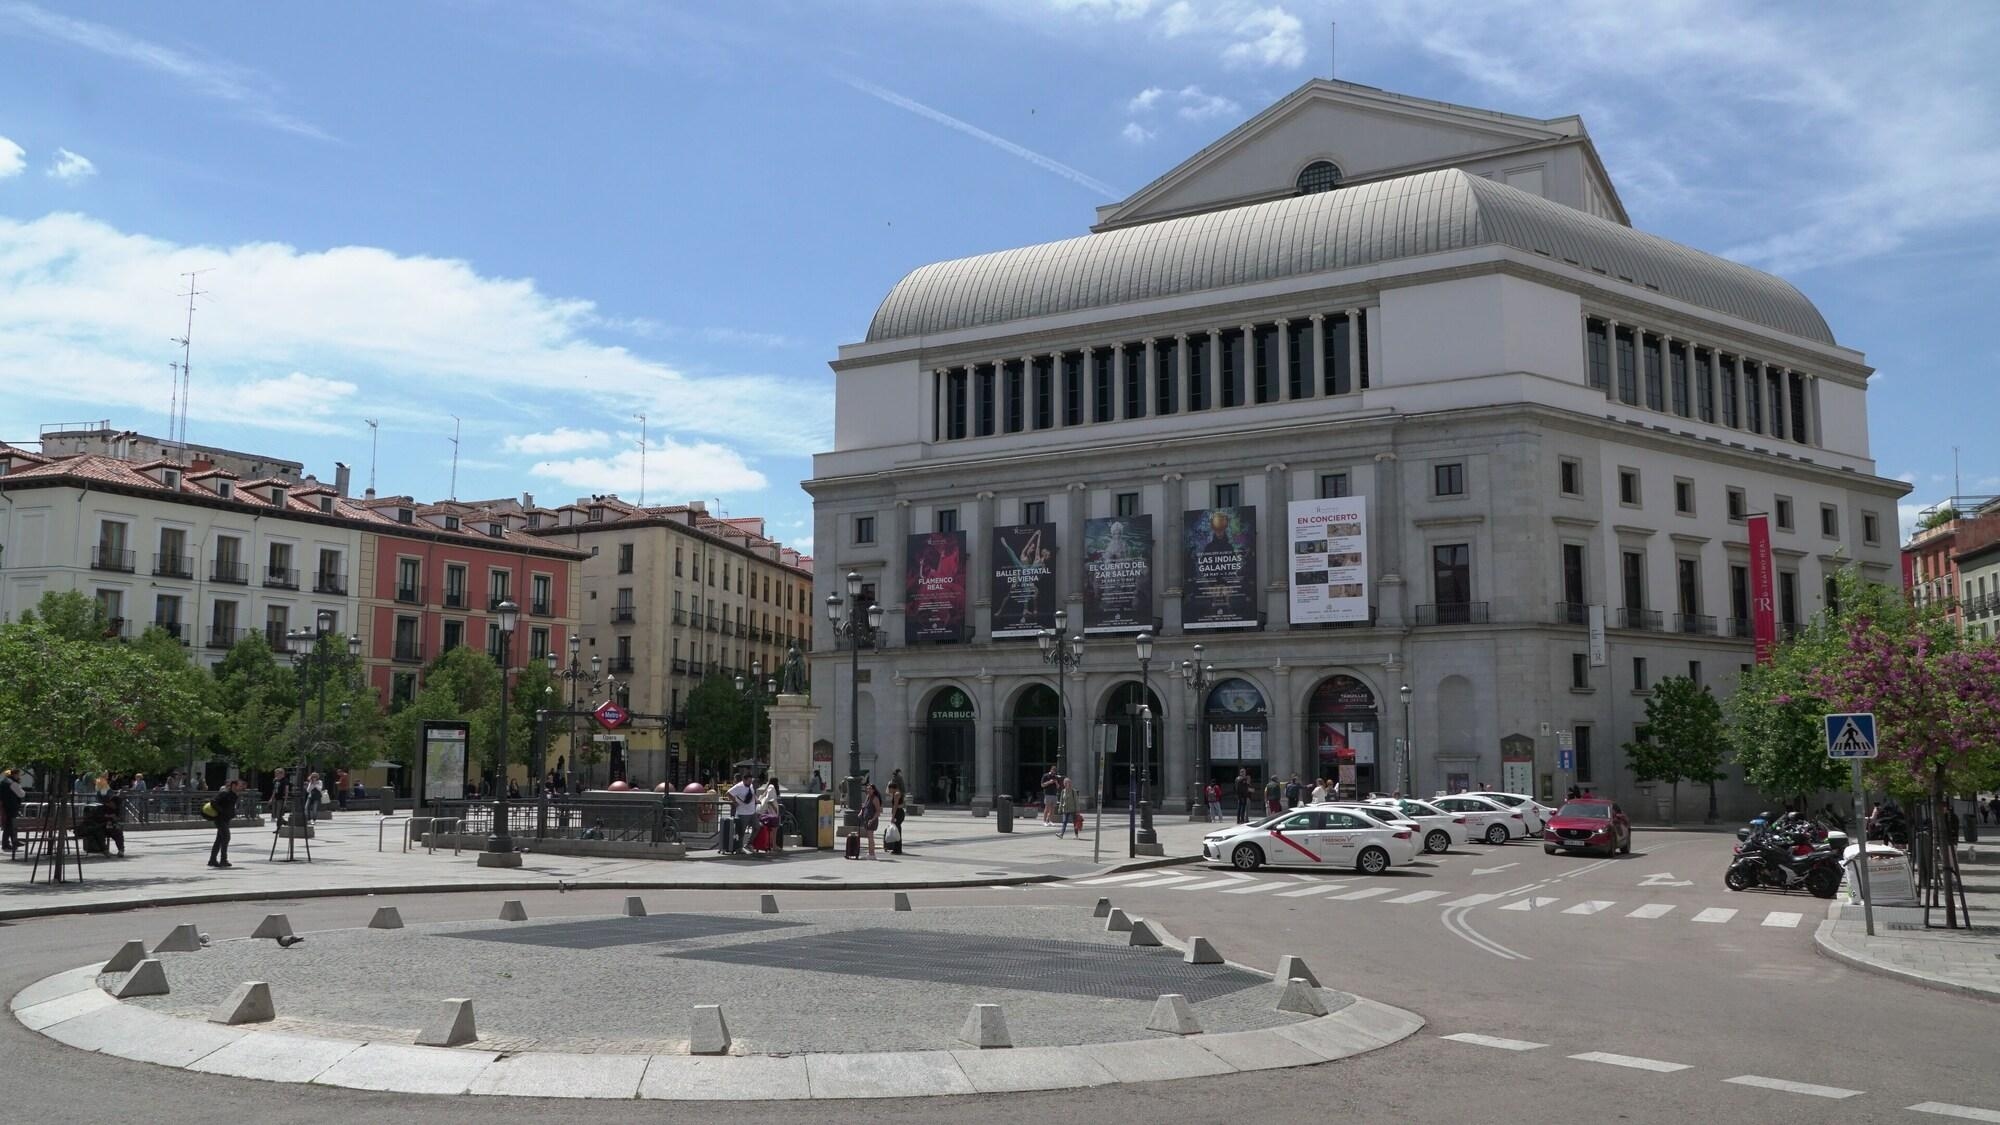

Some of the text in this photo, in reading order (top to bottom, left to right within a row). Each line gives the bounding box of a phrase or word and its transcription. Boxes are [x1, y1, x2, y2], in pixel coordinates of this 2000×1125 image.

[1310, 513, 1358, 523] CONCIERTO
[1198, 554, 1242, 564] LAS INDIAS
[1100, 562, 1131, 571] CUENTO
[1131, 561, 1147, 569] DEL
[1199, 562, 1242, 572] GALANTES
[995, 567, 1051, 578] BALLET ESTATAL
[1095, 571, 1111, 579] ZAR
[918, 576, 953, 585] FLAMENCO
[604, 711, 619, 719] Metro
